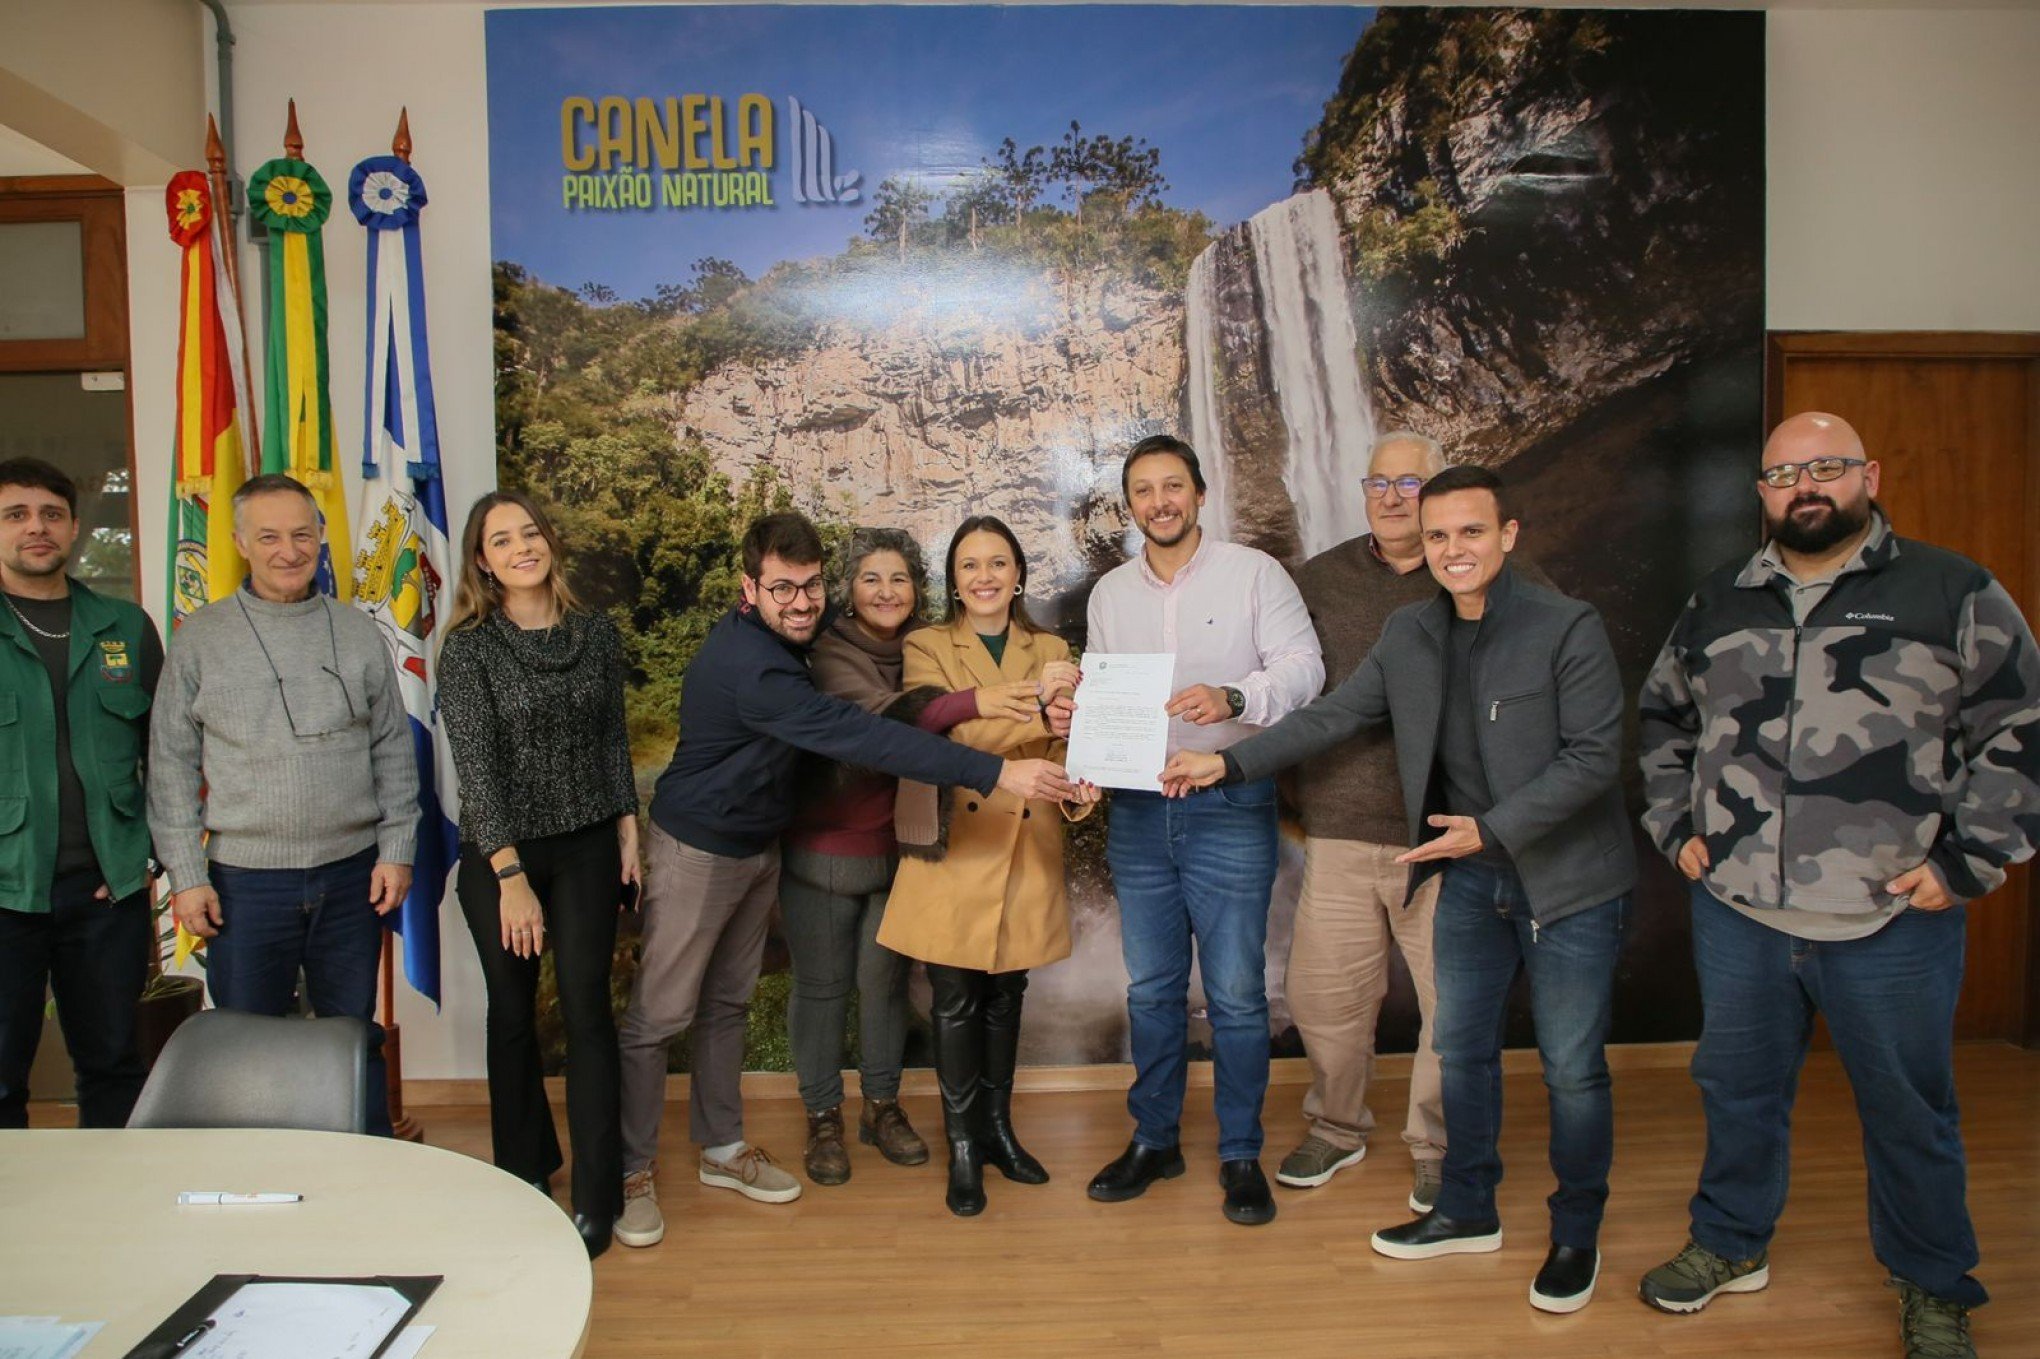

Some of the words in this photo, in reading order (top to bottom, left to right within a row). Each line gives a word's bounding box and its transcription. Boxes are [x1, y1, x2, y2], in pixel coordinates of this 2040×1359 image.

[560, 93, 774, 171] CANELA
[562, 166, 650, 208] PAIXÃO
[662, 172, 774, 206] NATURAL
[1854, 612, 1895, 621] Columbia
